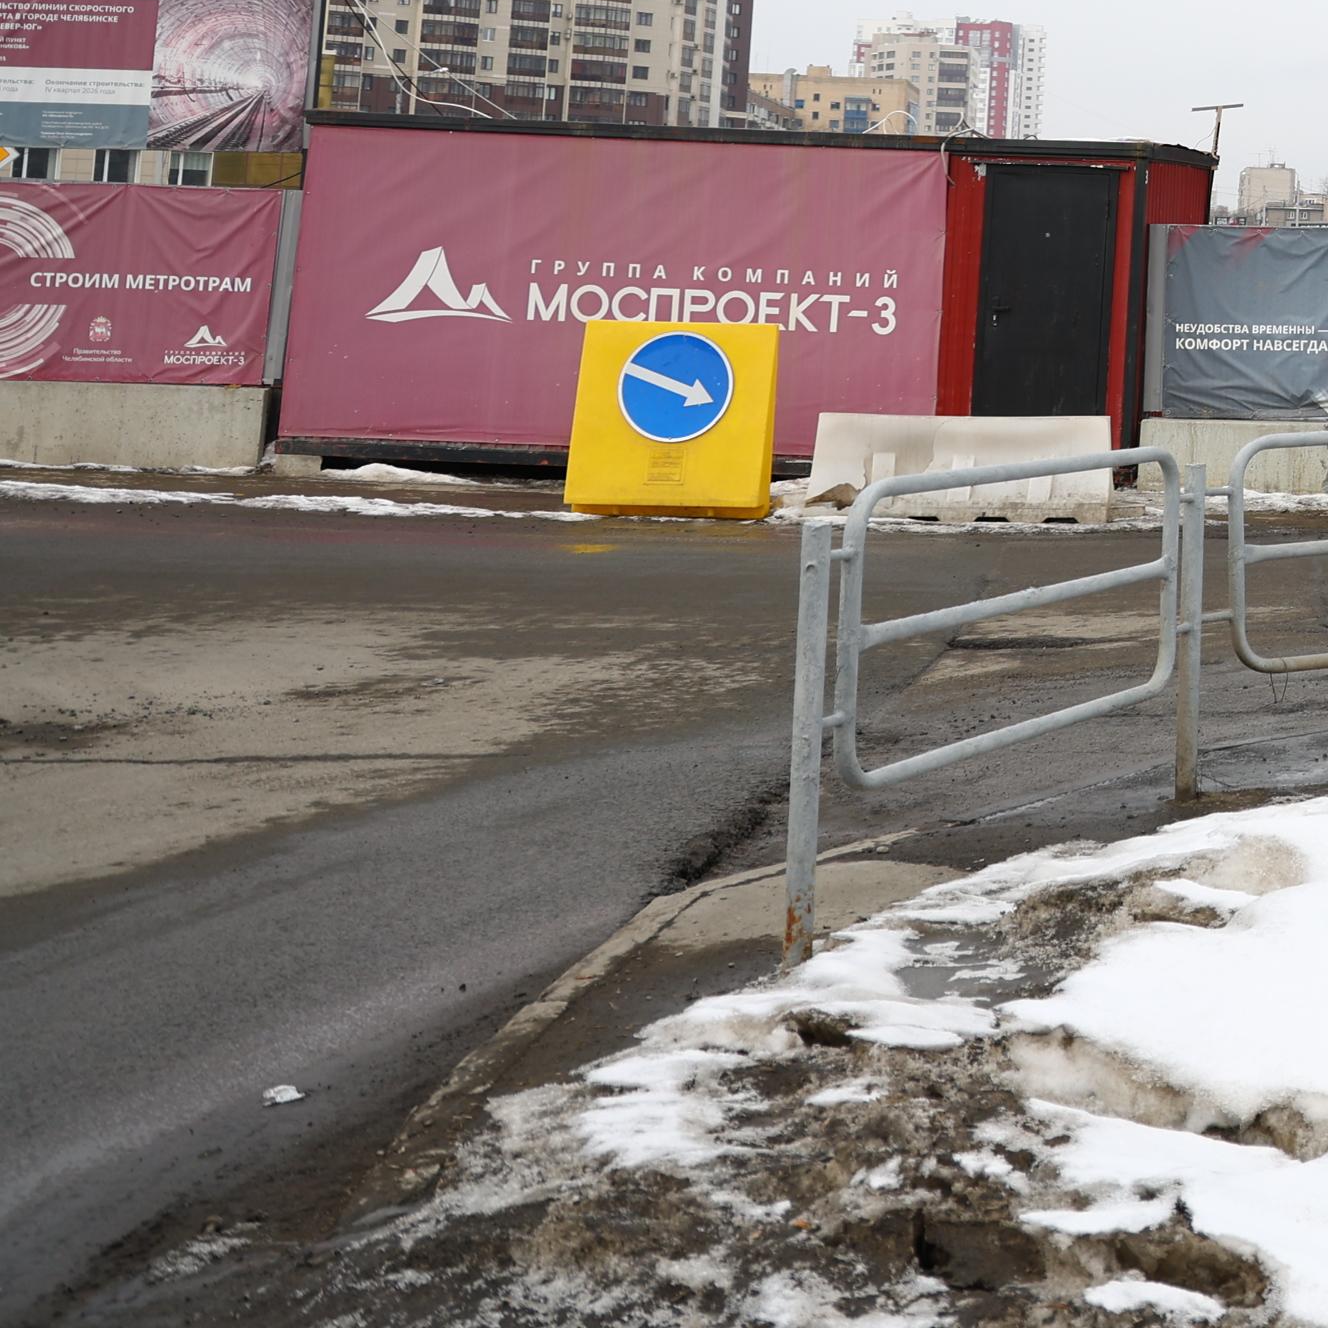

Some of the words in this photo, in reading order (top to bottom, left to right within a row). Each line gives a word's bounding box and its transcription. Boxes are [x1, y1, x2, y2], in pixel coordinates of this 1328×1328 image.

[32, 3, 67, 11] ЛИНИИ
[69, 5, 135, 13] СКОРОСТНОГО
[23, 13, 59, 22] ГОРОДЕ
[61, 15, 119, 23] ЧЕЛЯБИНСКЕ
[530, 259, 667, 279] ГРУППА
[693, 266, 898, 289] КОМПАНИЙ
[30, 272, 120, 289] СТРОИМ
[125, 275, 252, 292] МЕТРОТРАМ
[526, 282, 897, 335] МОСПРОЕКТ-3
[1175, 323, 1250, 335] НЕУДОБСТВА
[1252, 324, 1315, 335] ВРЕМЕННЫ
[1175, 338, 1250, 351] КОМФОРТ
[1253, 339, 1328, 354] НАВСЕГДА
[164, 354, 245, 366] МОСПРОЕКТ-3
